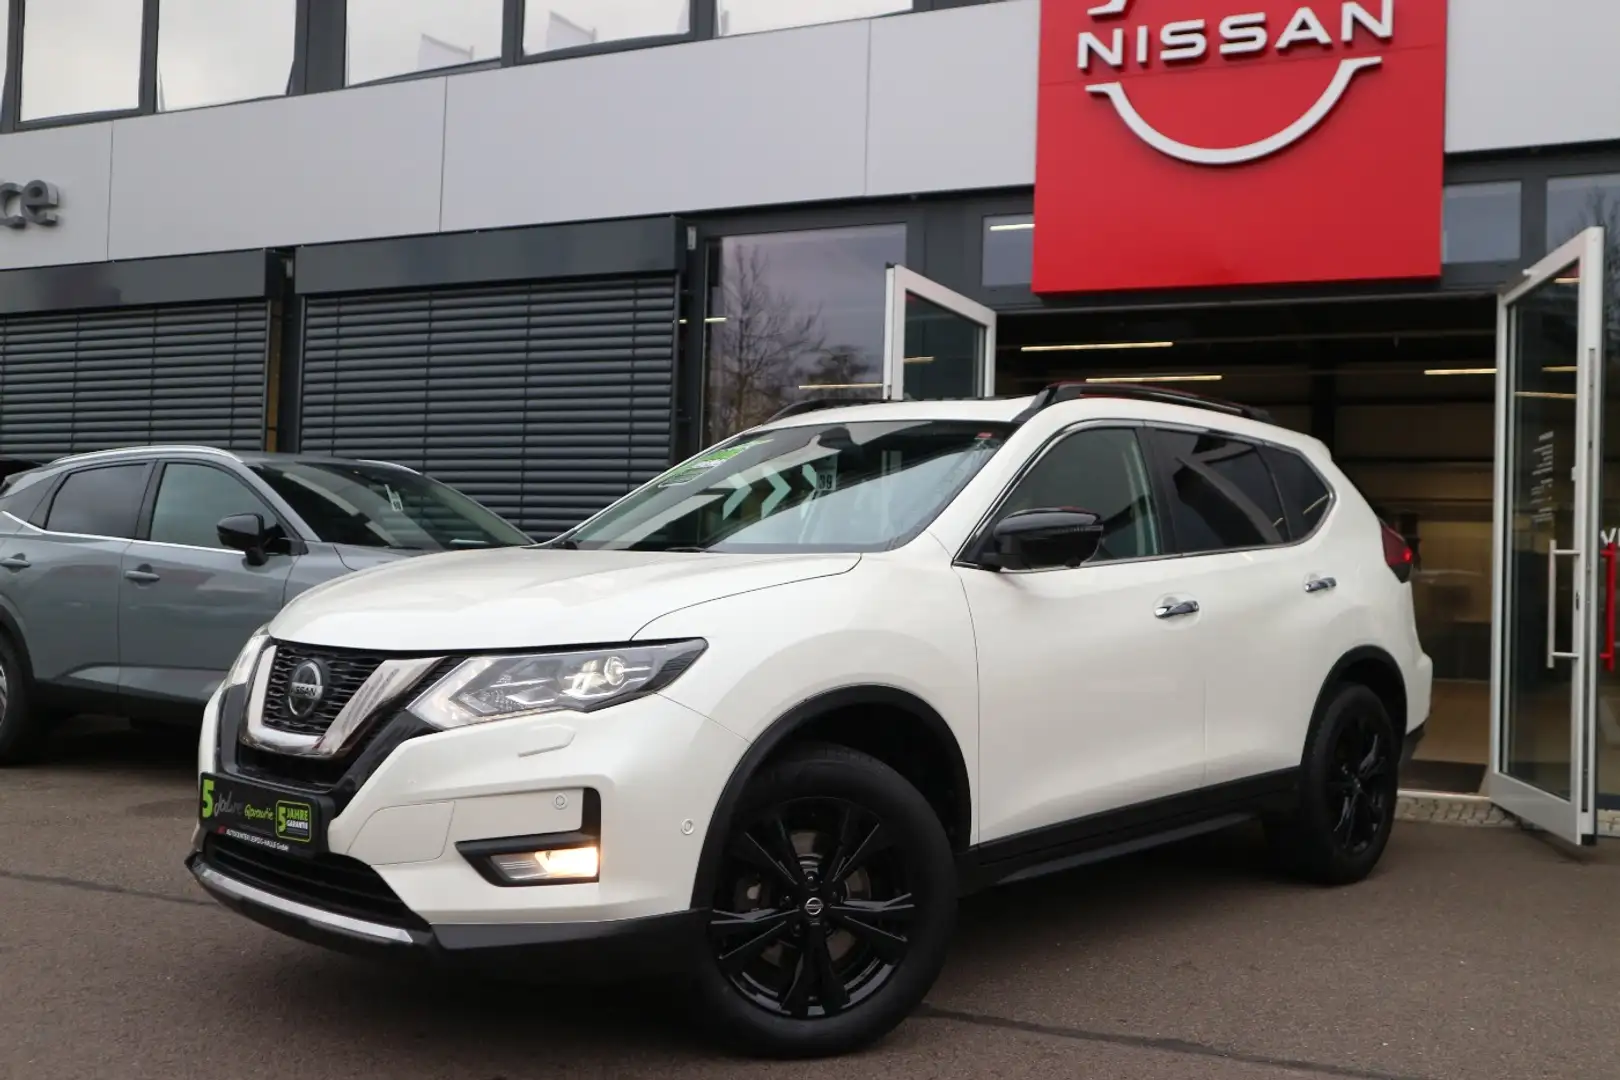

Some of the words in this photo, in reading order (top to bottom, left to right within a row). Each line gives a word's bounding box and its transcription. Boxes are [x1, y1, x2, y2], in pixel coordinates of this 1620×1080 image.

[1077, 0, 1394, 70] NISSAN
[202, 779, 214, 818] 5
[278, 806, 286, 832] 5
[286, 807, 308, 821] JAHRE
